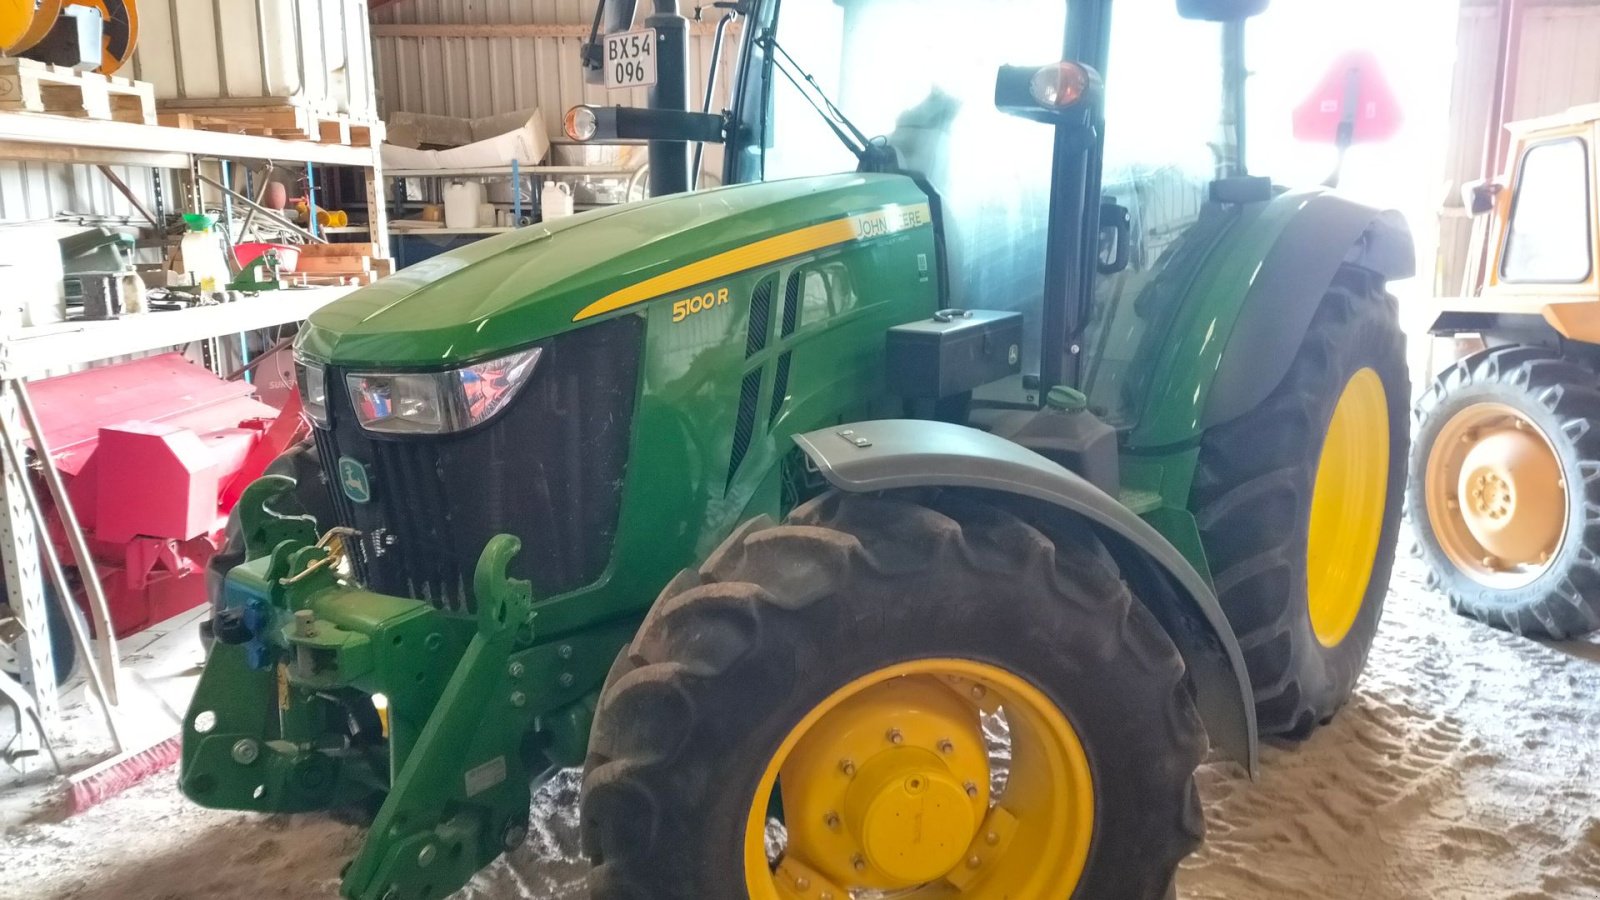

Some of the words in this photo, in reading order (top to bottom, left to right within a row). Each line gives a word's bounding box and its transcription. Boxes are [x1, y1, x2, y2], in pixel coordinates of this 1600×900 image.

[609, 34, 650, 61] BX54
[616, 61, 644, 84] 096
[857, 216, 888, 237] JOHN
[892, 210, 922, 230] ERE
[672, 291, 715, 323] 5100
[717, 287, 729, 306] R
